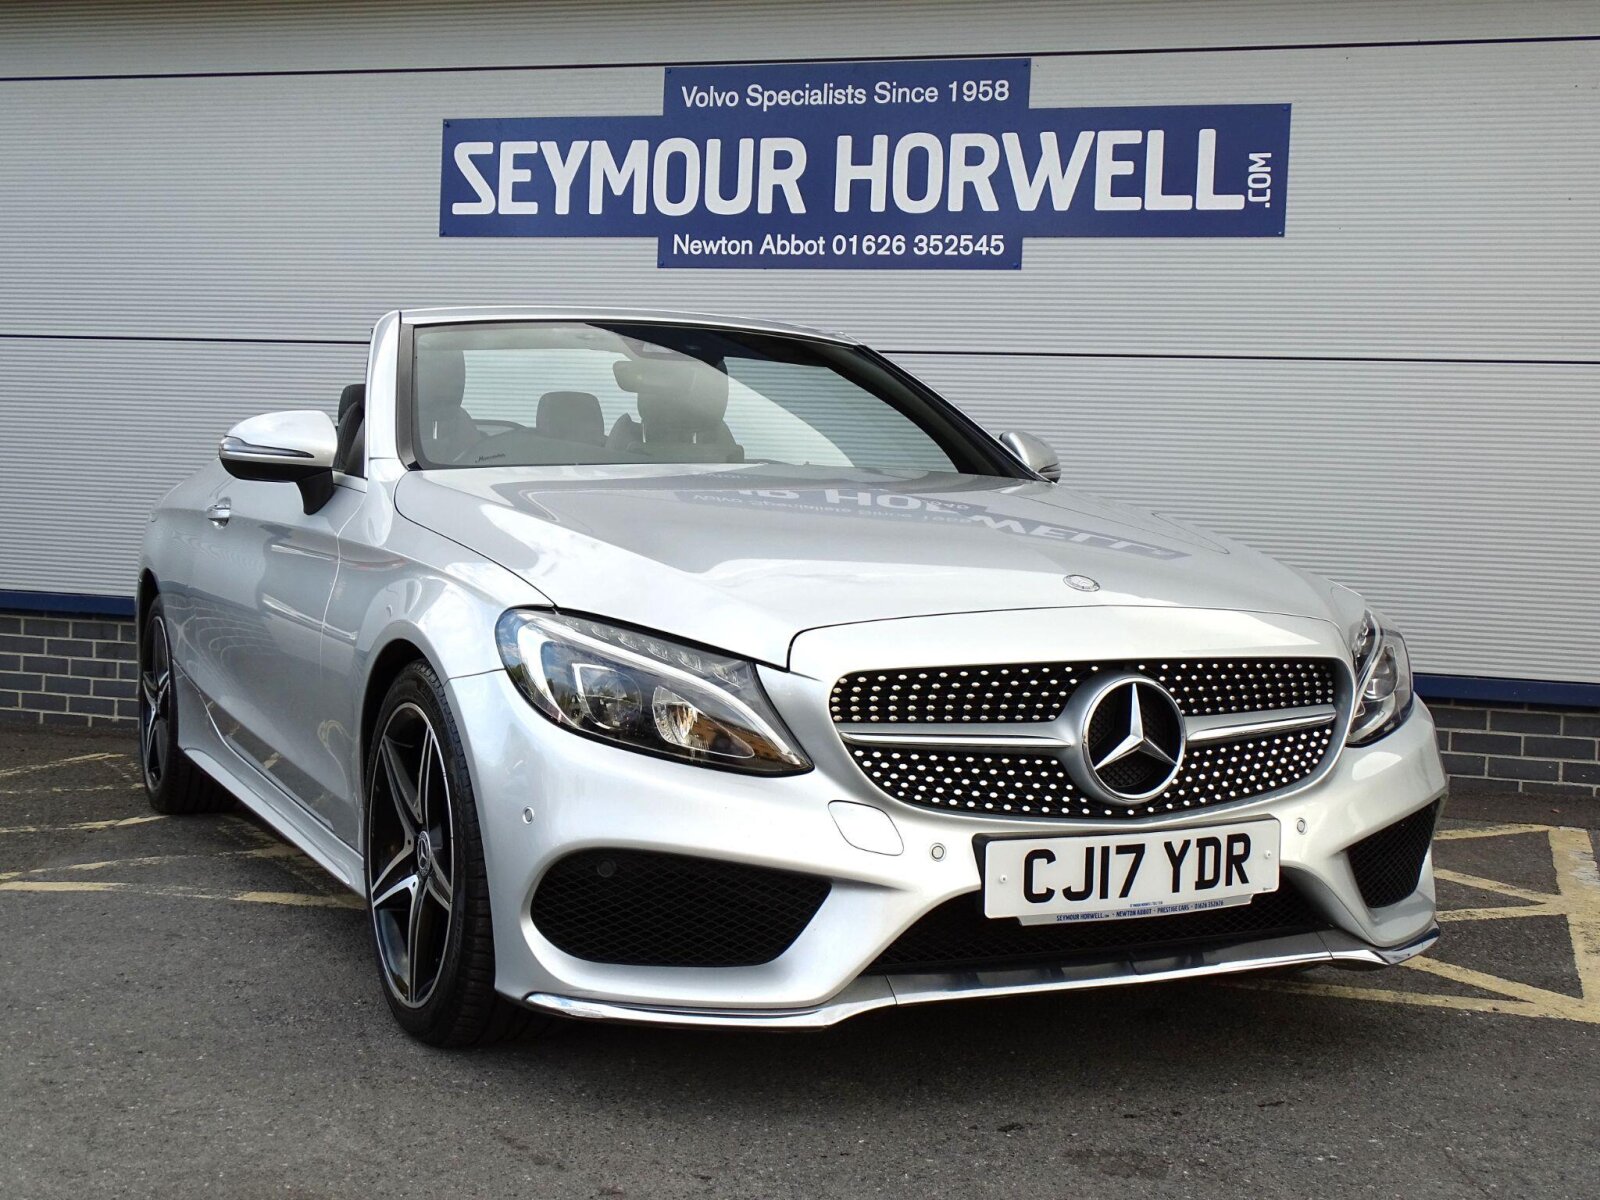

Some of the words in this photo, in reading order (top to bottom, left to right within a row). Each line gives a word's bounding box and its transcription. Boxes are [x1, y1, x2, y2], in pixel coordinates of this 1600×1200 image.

[681, 85, 739, 108] Volvo
[745, 82, 867, 113] Specialists
[873, 81, 939, 104] Since
[948, 79, 1010, 102] 1958
[451, 137, 807, 216] SEYMOUR
[834, 129, 1245, 214] HORWELL
[1247, 152, 1272, 208] .COM
[673, 233, 753, 256] Newton
[759, 233, 826, 256] Abbot
[832, 234, 906, 256] 01626
[912, 234, 1005, 256] 352545
[1023, 843, 1146, 904] CJ17
[1163, 832, 1251, 894] YDR
[1056, 912, 1080, 922] SEYMOUR
[1116, 909, 1136, 918] NEWTON
[1157, 904, 1178, 914] PRESTIGE
[1179, 903, 1190, 912] CARS
